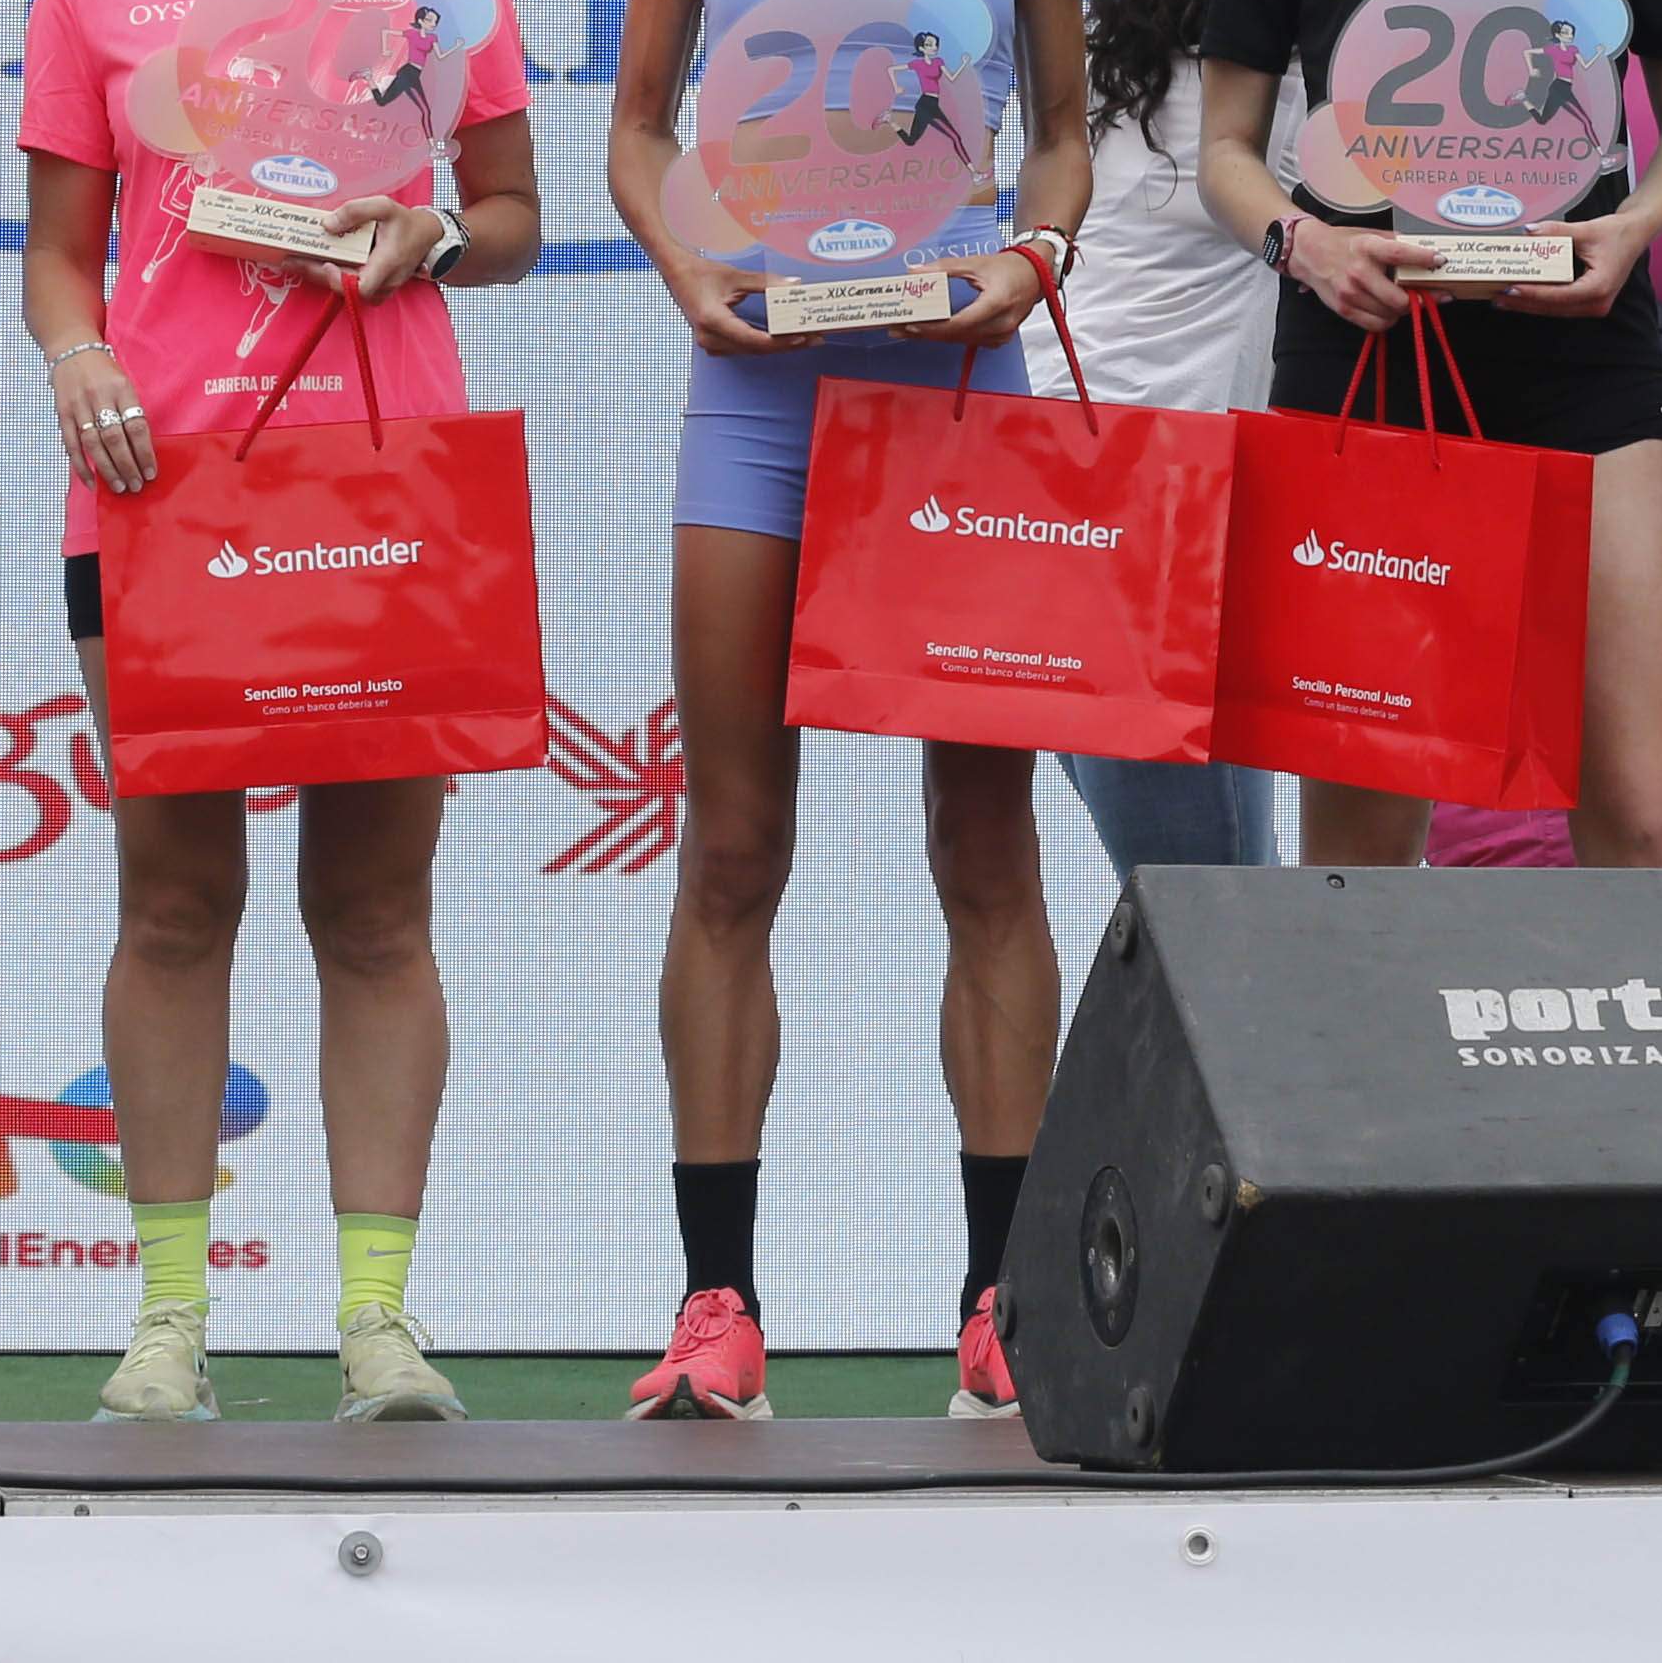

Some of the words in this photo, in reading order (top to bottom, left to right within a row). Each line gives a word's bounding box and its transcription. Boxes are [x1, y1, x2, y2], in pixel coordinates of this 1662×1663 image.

[1365, 4, 1554, 129] 20
[731, 21, 917, 166] 20
[1345, 135, 1592, 161] ANIVERSARIO
[256, 165, 330, 190] ASTURIANA
[714, 157, 963, 200] ANIVERSARIO
[1382, 170, 1458, 184] CARRERA
[1467, 170, 1486, 184] DE
[1494, 171, 1514, 184] LA
[1521, 171, 1578, 185] MUJER
[252, 204, 273, 216] XIX
[273, 209, 308, 223] Carrera
[1444, 200, 1517, 217] ASTURIANA
[815, 234, 889, 253] ASTURIANA
[1456, 242, 1475, 252] XIX
[1476, 242, 1511, 253] Carrera
[1529, 240, 1564, 259] Mujer
[826, 287, 848, 299] XIX
[848, 286, 883, 298] Carrera
[901, 277, 937, 299] Mujer
[205, 376, 257, 395] CARRERA
[300, 375, 343, 391] MUJER
[955, 506, 1124, 551] Santander
[253, 537, 424, 576] Santander
[1327, 539, 1451, 588] Santander
[926, 642, 978, 659] Sencillo
[983, 647, 1042, 666] Personal
[1045, 654, 1082, 670] Justo
[941, 661, 969, 673] Como
[971, 666, 983, 674] un
[986, 666, 1014, 678] banco
[1052, 674, 1066, 683] ser
[244, 686, 298, 702] Sencillo
[302, 681, 361, 697] Personal
[366, 678, 403, 693] Justo
[1292, 676, 1332, 694] Sencillo
[1335, 683, 1381, 702] Personal
[1383, 691, 1412, 708] Justo
[262, 705, 290, 715] Como
[292, 705, 305, 713] un
[307, 700, 336, 712] banco
[374, 699, 389, 707] ser
